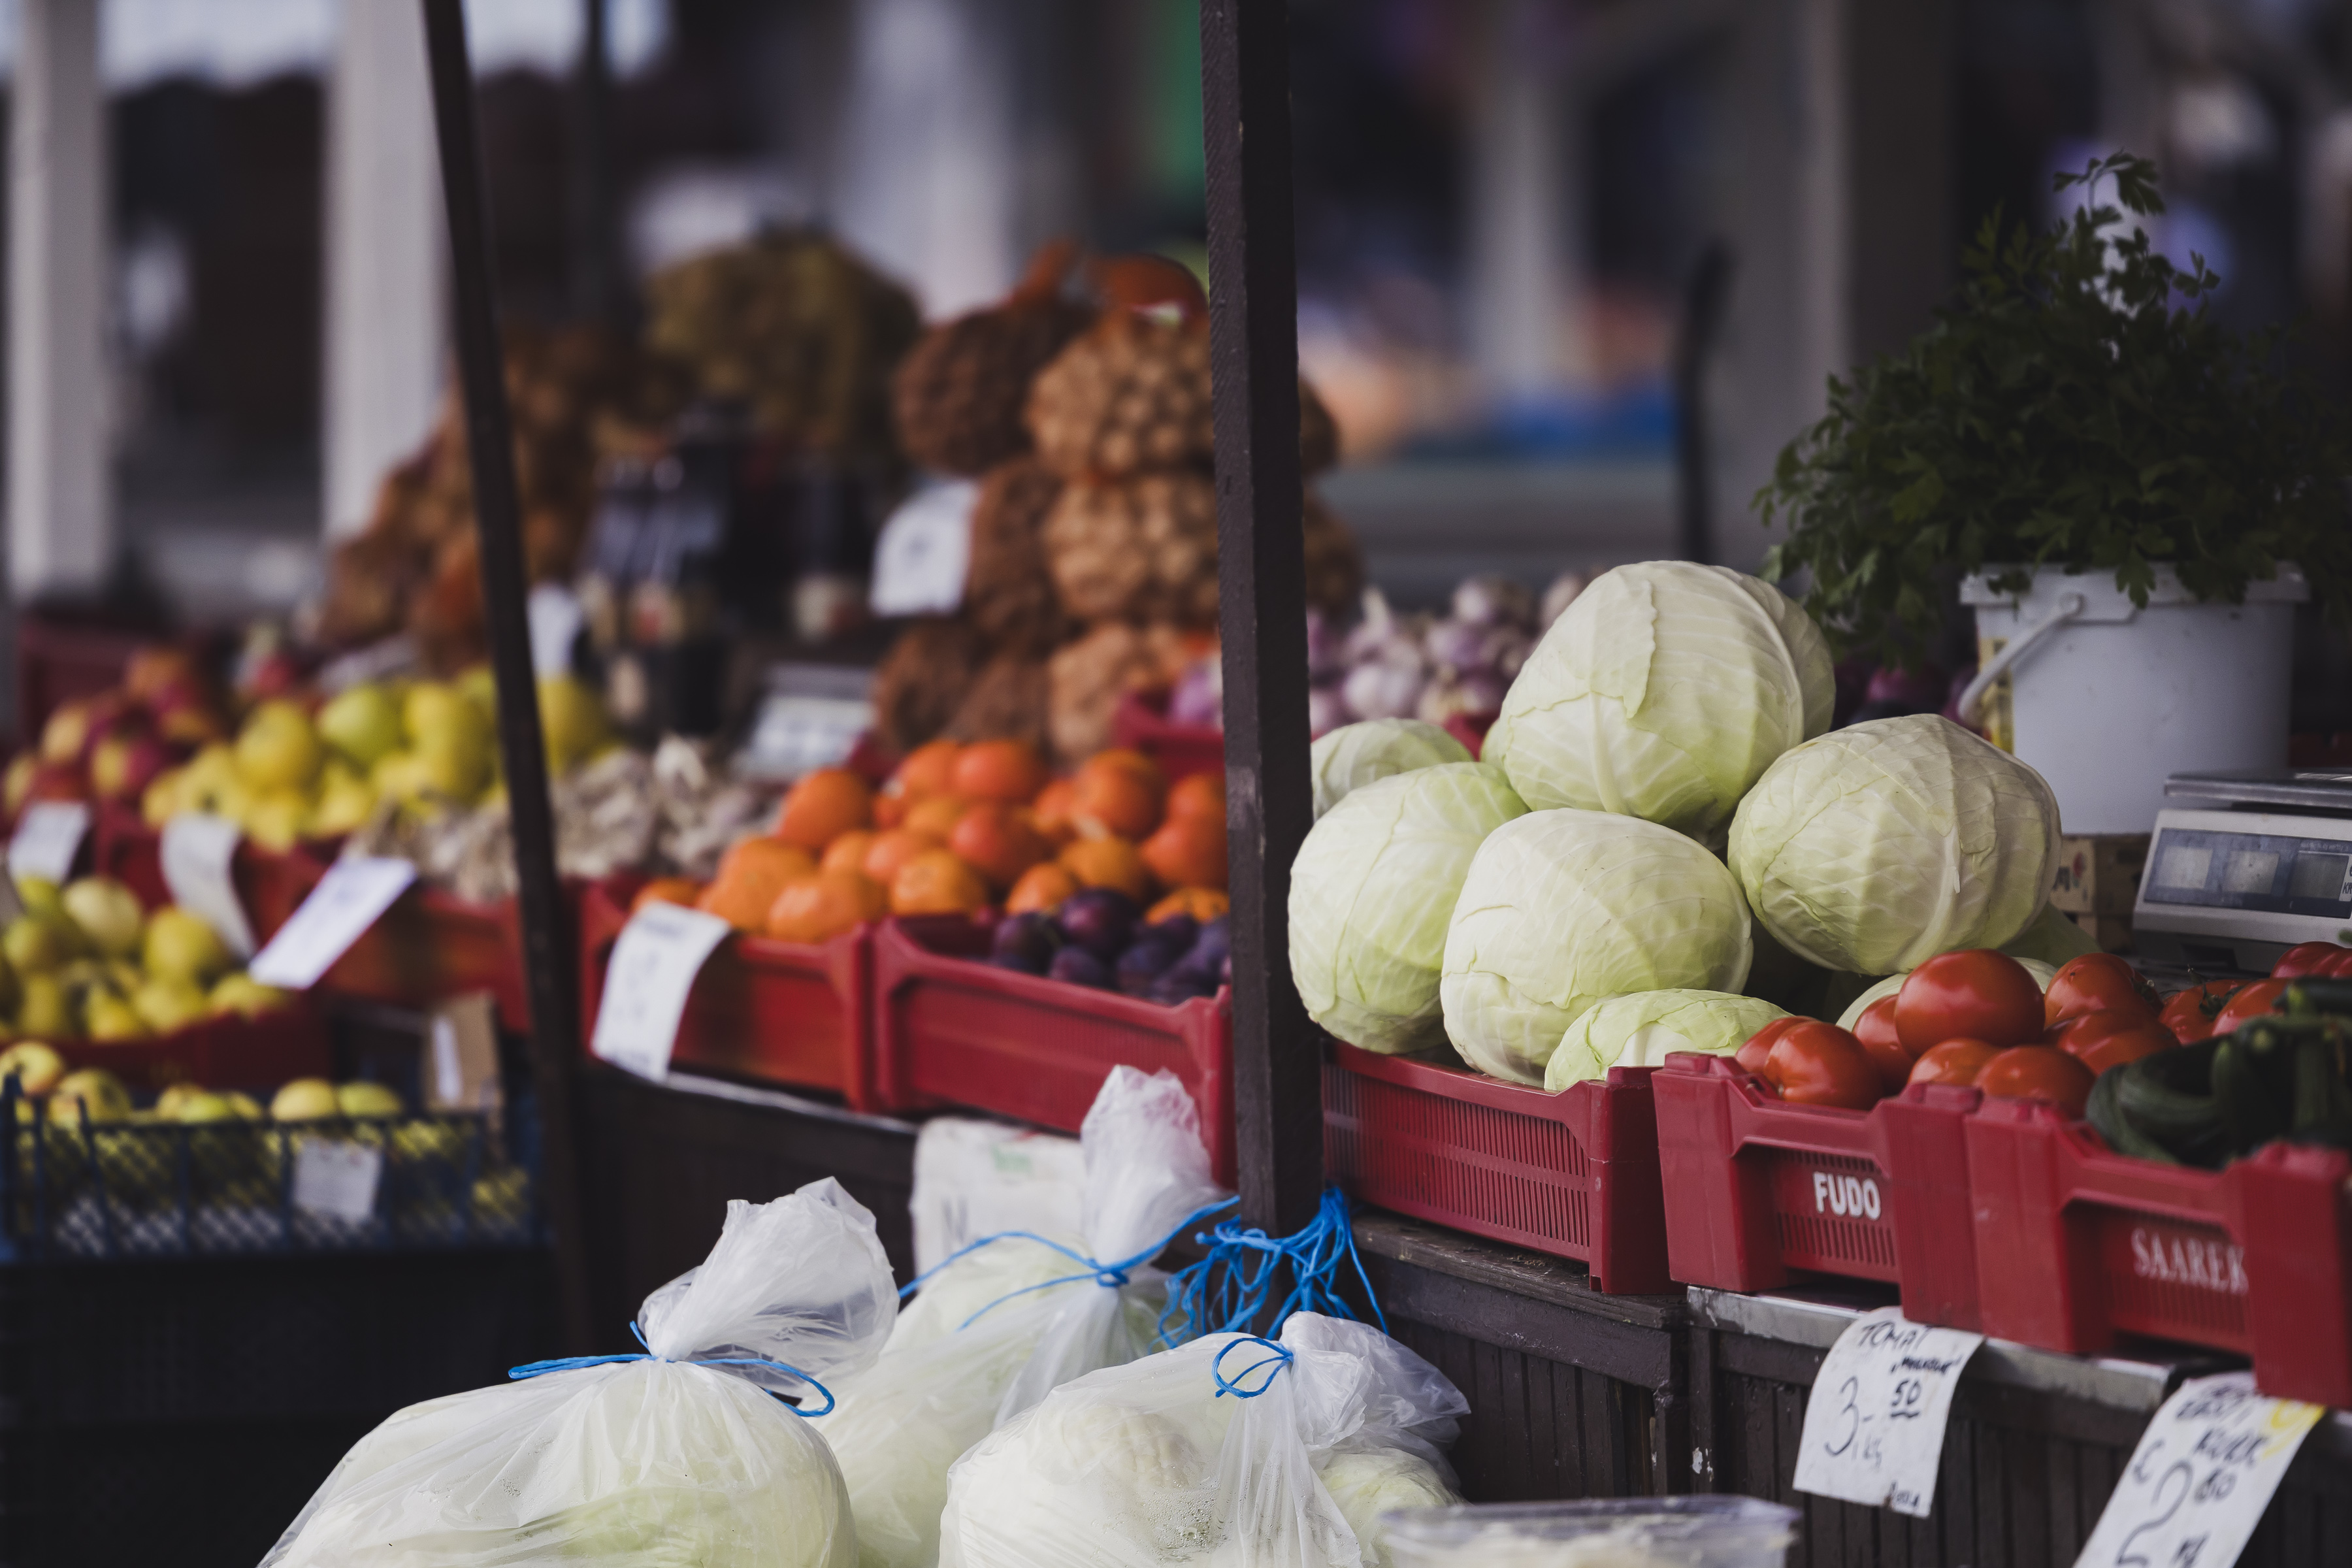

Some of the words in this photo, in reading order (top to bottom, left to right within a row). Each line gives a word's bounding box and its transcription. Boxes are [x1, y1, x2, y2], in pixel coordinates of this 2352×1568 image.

[1812, 1171, 1882, 1220] FUDO
[2131, 1228, 2249, 1296] SAAREK
[1891, 1379, 1921, 1407] 50
[2112, 1458, 2193, 1567] 2
